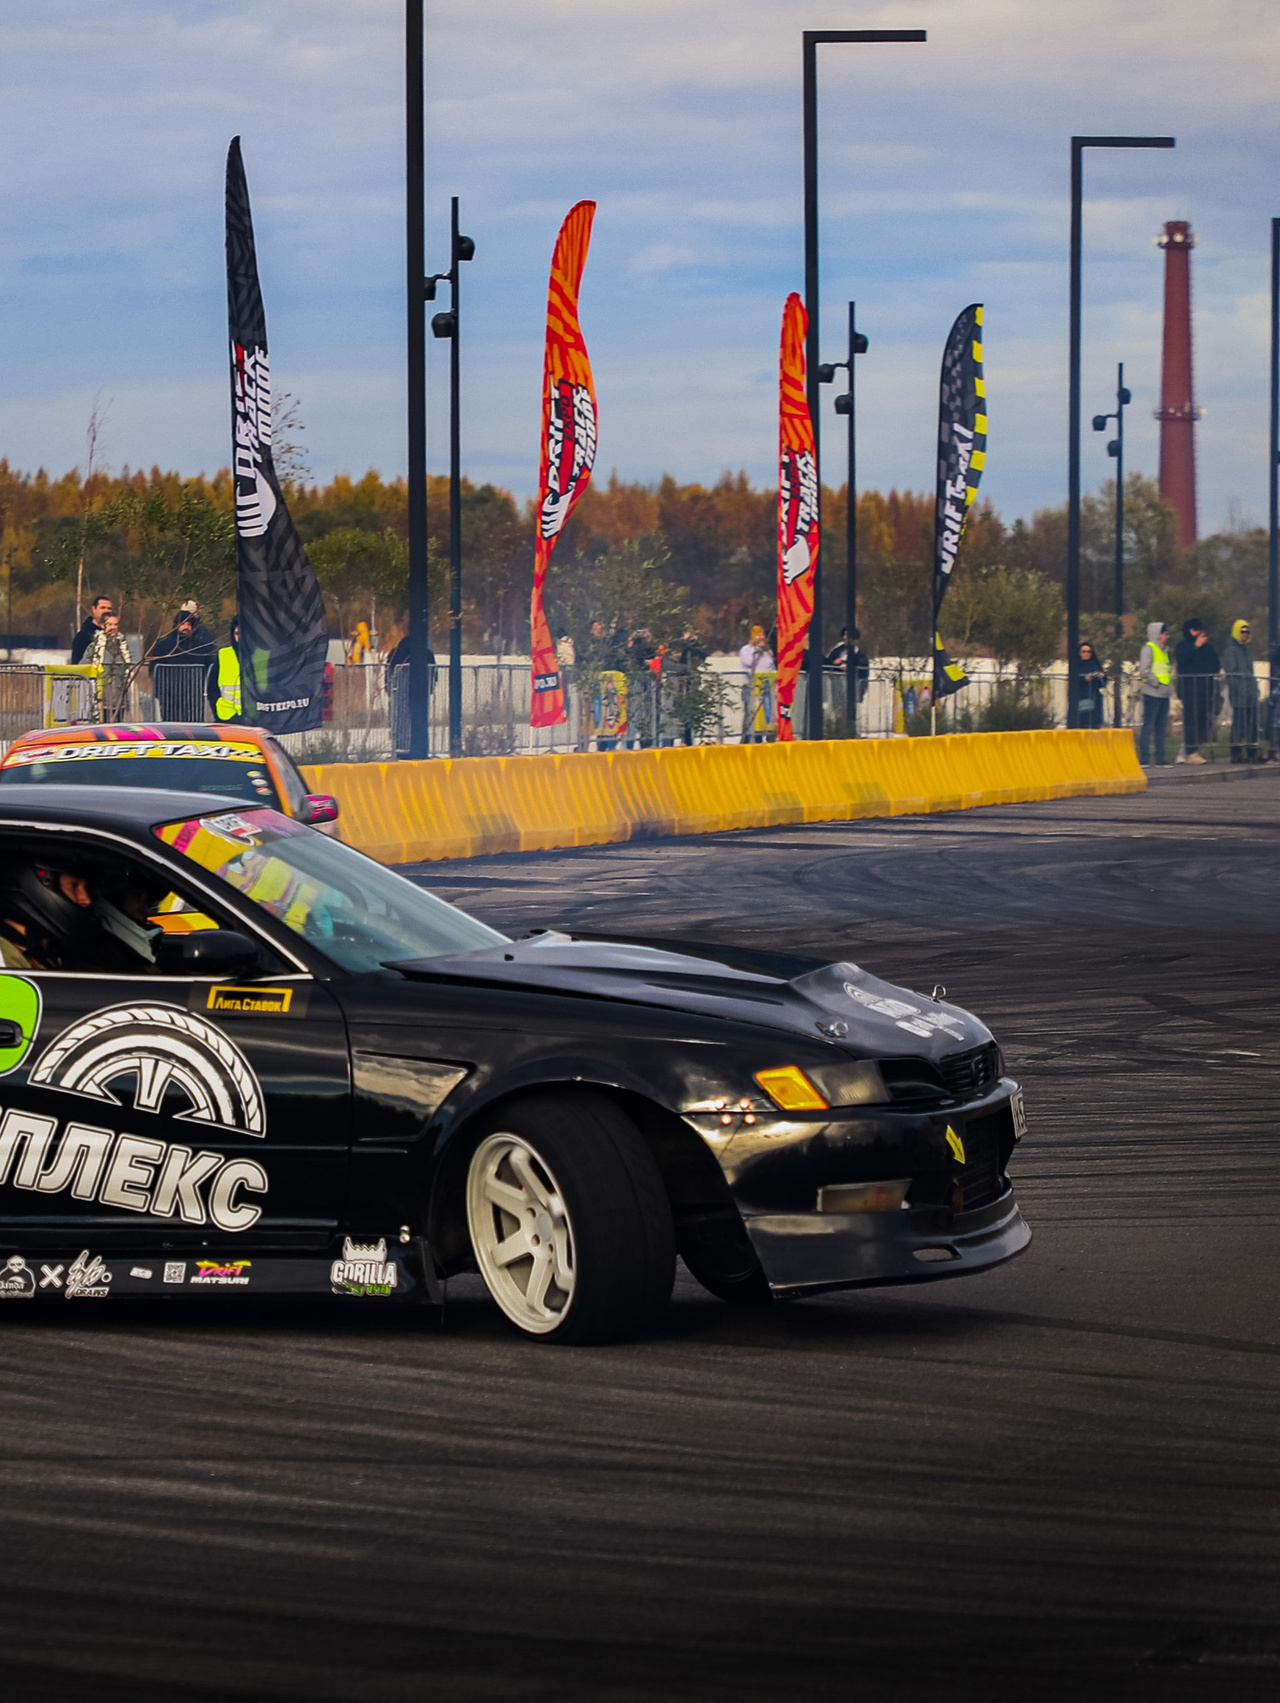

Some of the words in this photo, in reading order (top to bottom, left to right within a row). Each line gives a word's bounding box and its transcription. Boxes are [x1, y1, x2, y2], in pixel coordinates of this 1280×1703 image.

[58, 743, 155, 759] DRIFT
[160, 743, 231, 758] TAXI
[190, 1276, 249, 1285] MATSURI
